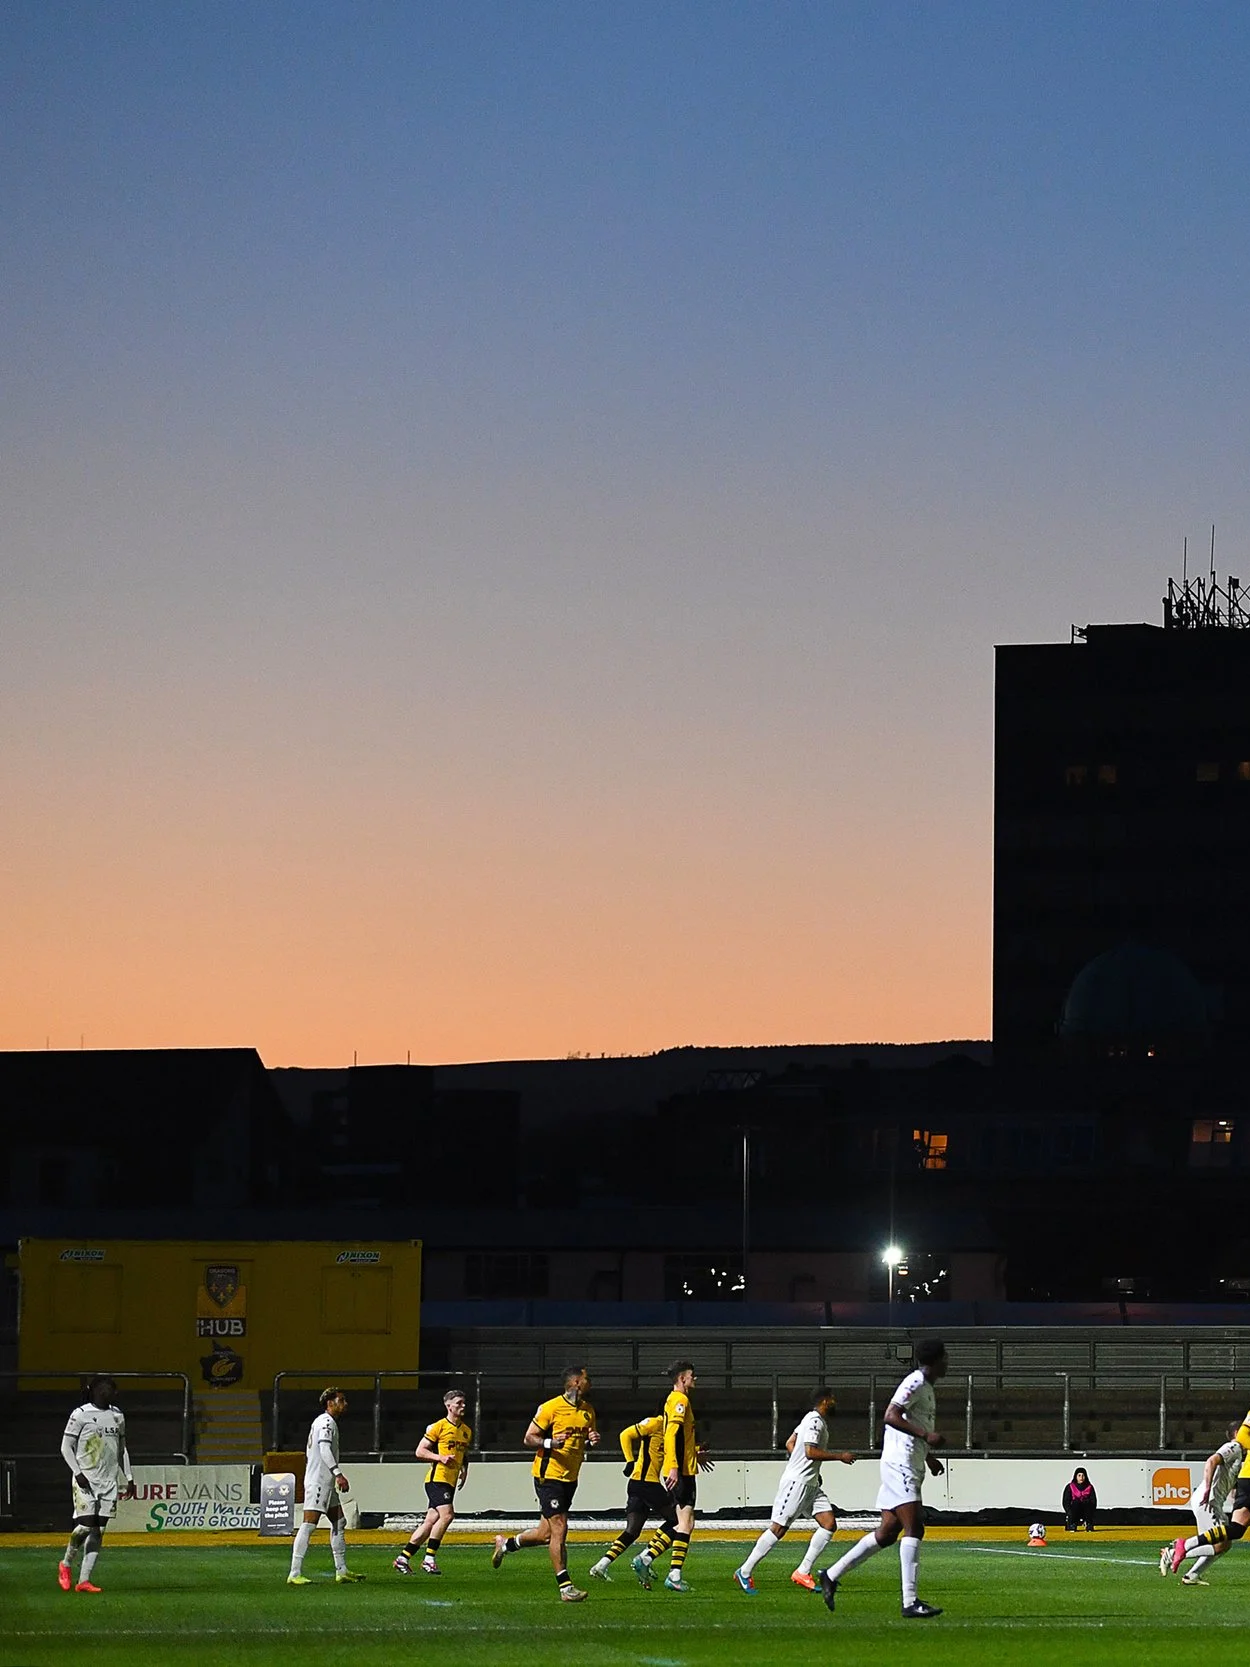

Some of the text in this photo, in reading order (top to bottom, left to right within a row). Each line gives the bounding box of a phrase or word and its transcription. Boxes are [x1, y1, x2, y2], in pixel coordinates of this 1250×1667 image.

[200, 1319, 244, 1335] HUB
[182, 1484, 243, 1501] VANS
[1153, 1483, 1189, 1502] phc
[213, 1502, 262, 1516] WALES
[208, 1515, 261, 1528] GROUN
